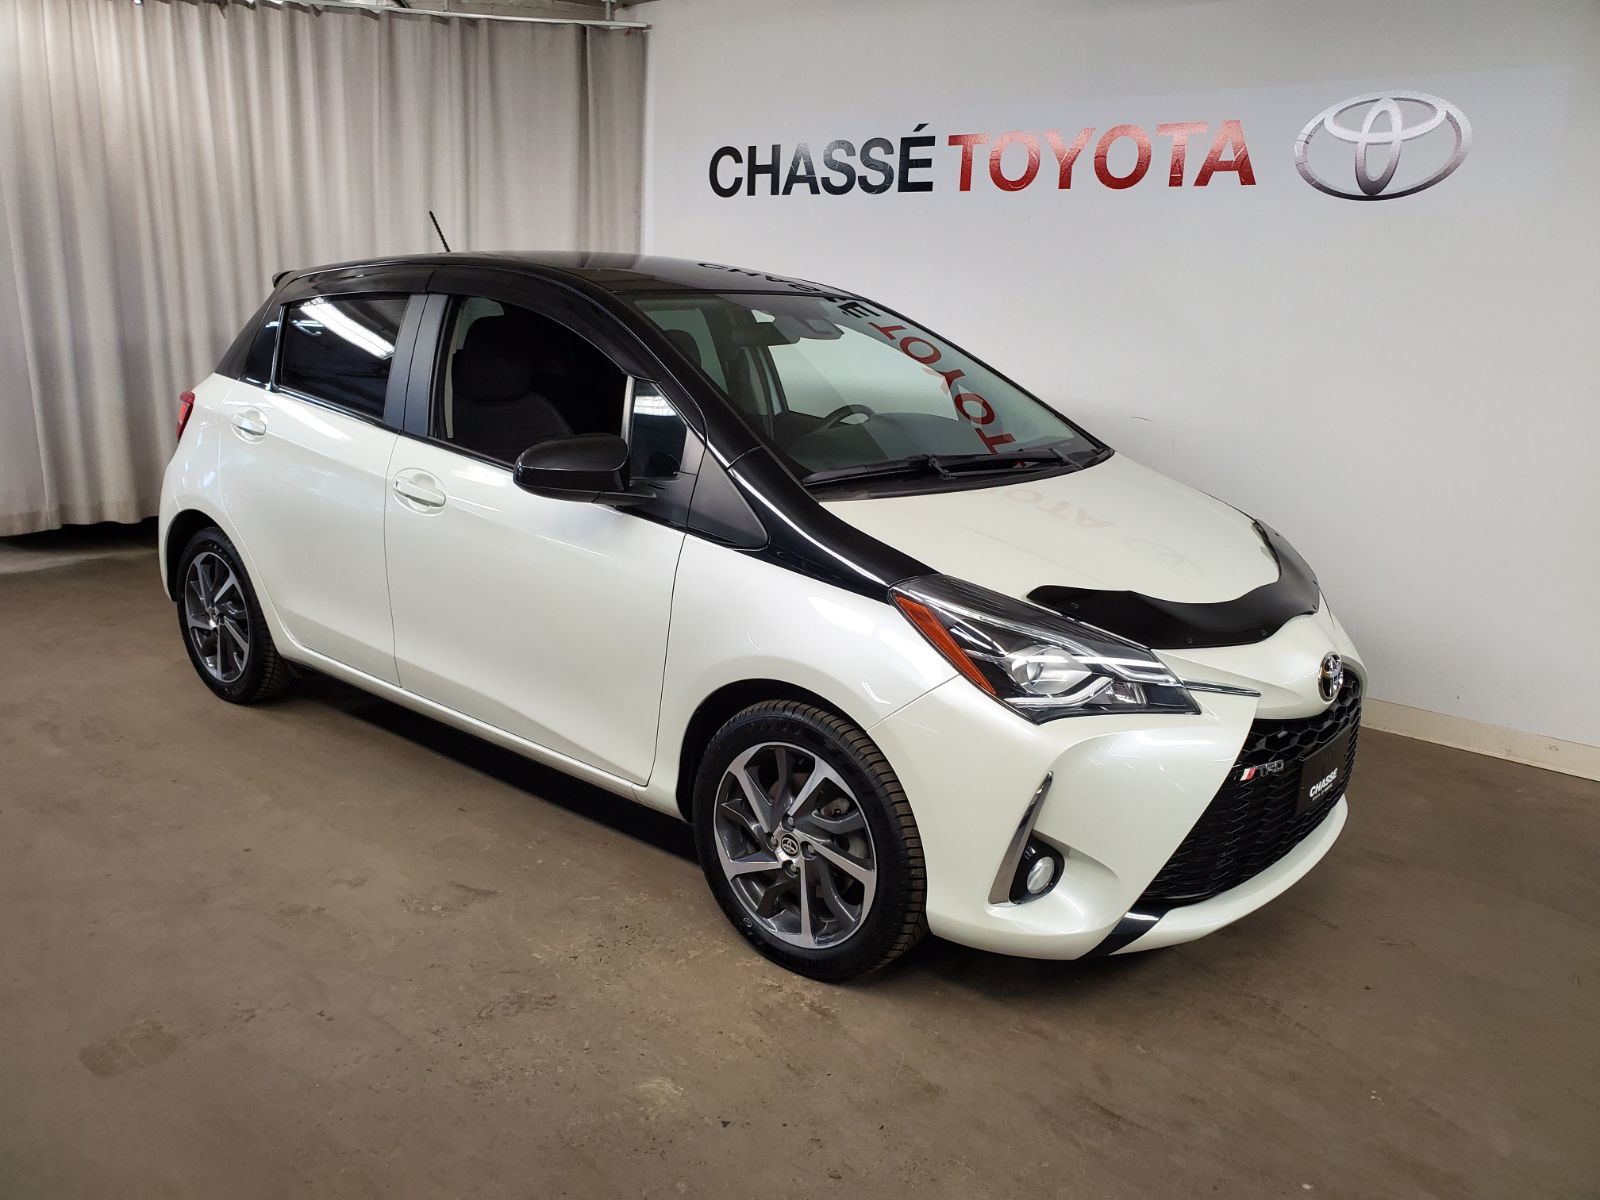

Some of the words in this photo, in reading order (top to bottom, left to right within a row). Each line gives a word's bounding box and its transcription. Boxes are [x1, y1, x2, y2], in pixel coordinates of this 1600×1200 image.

[709, 123, 936, 198] CHASSÉ
[947, 119, 1257, 192] TOYOTA
[1255, 759, 1285, 778] TRD
